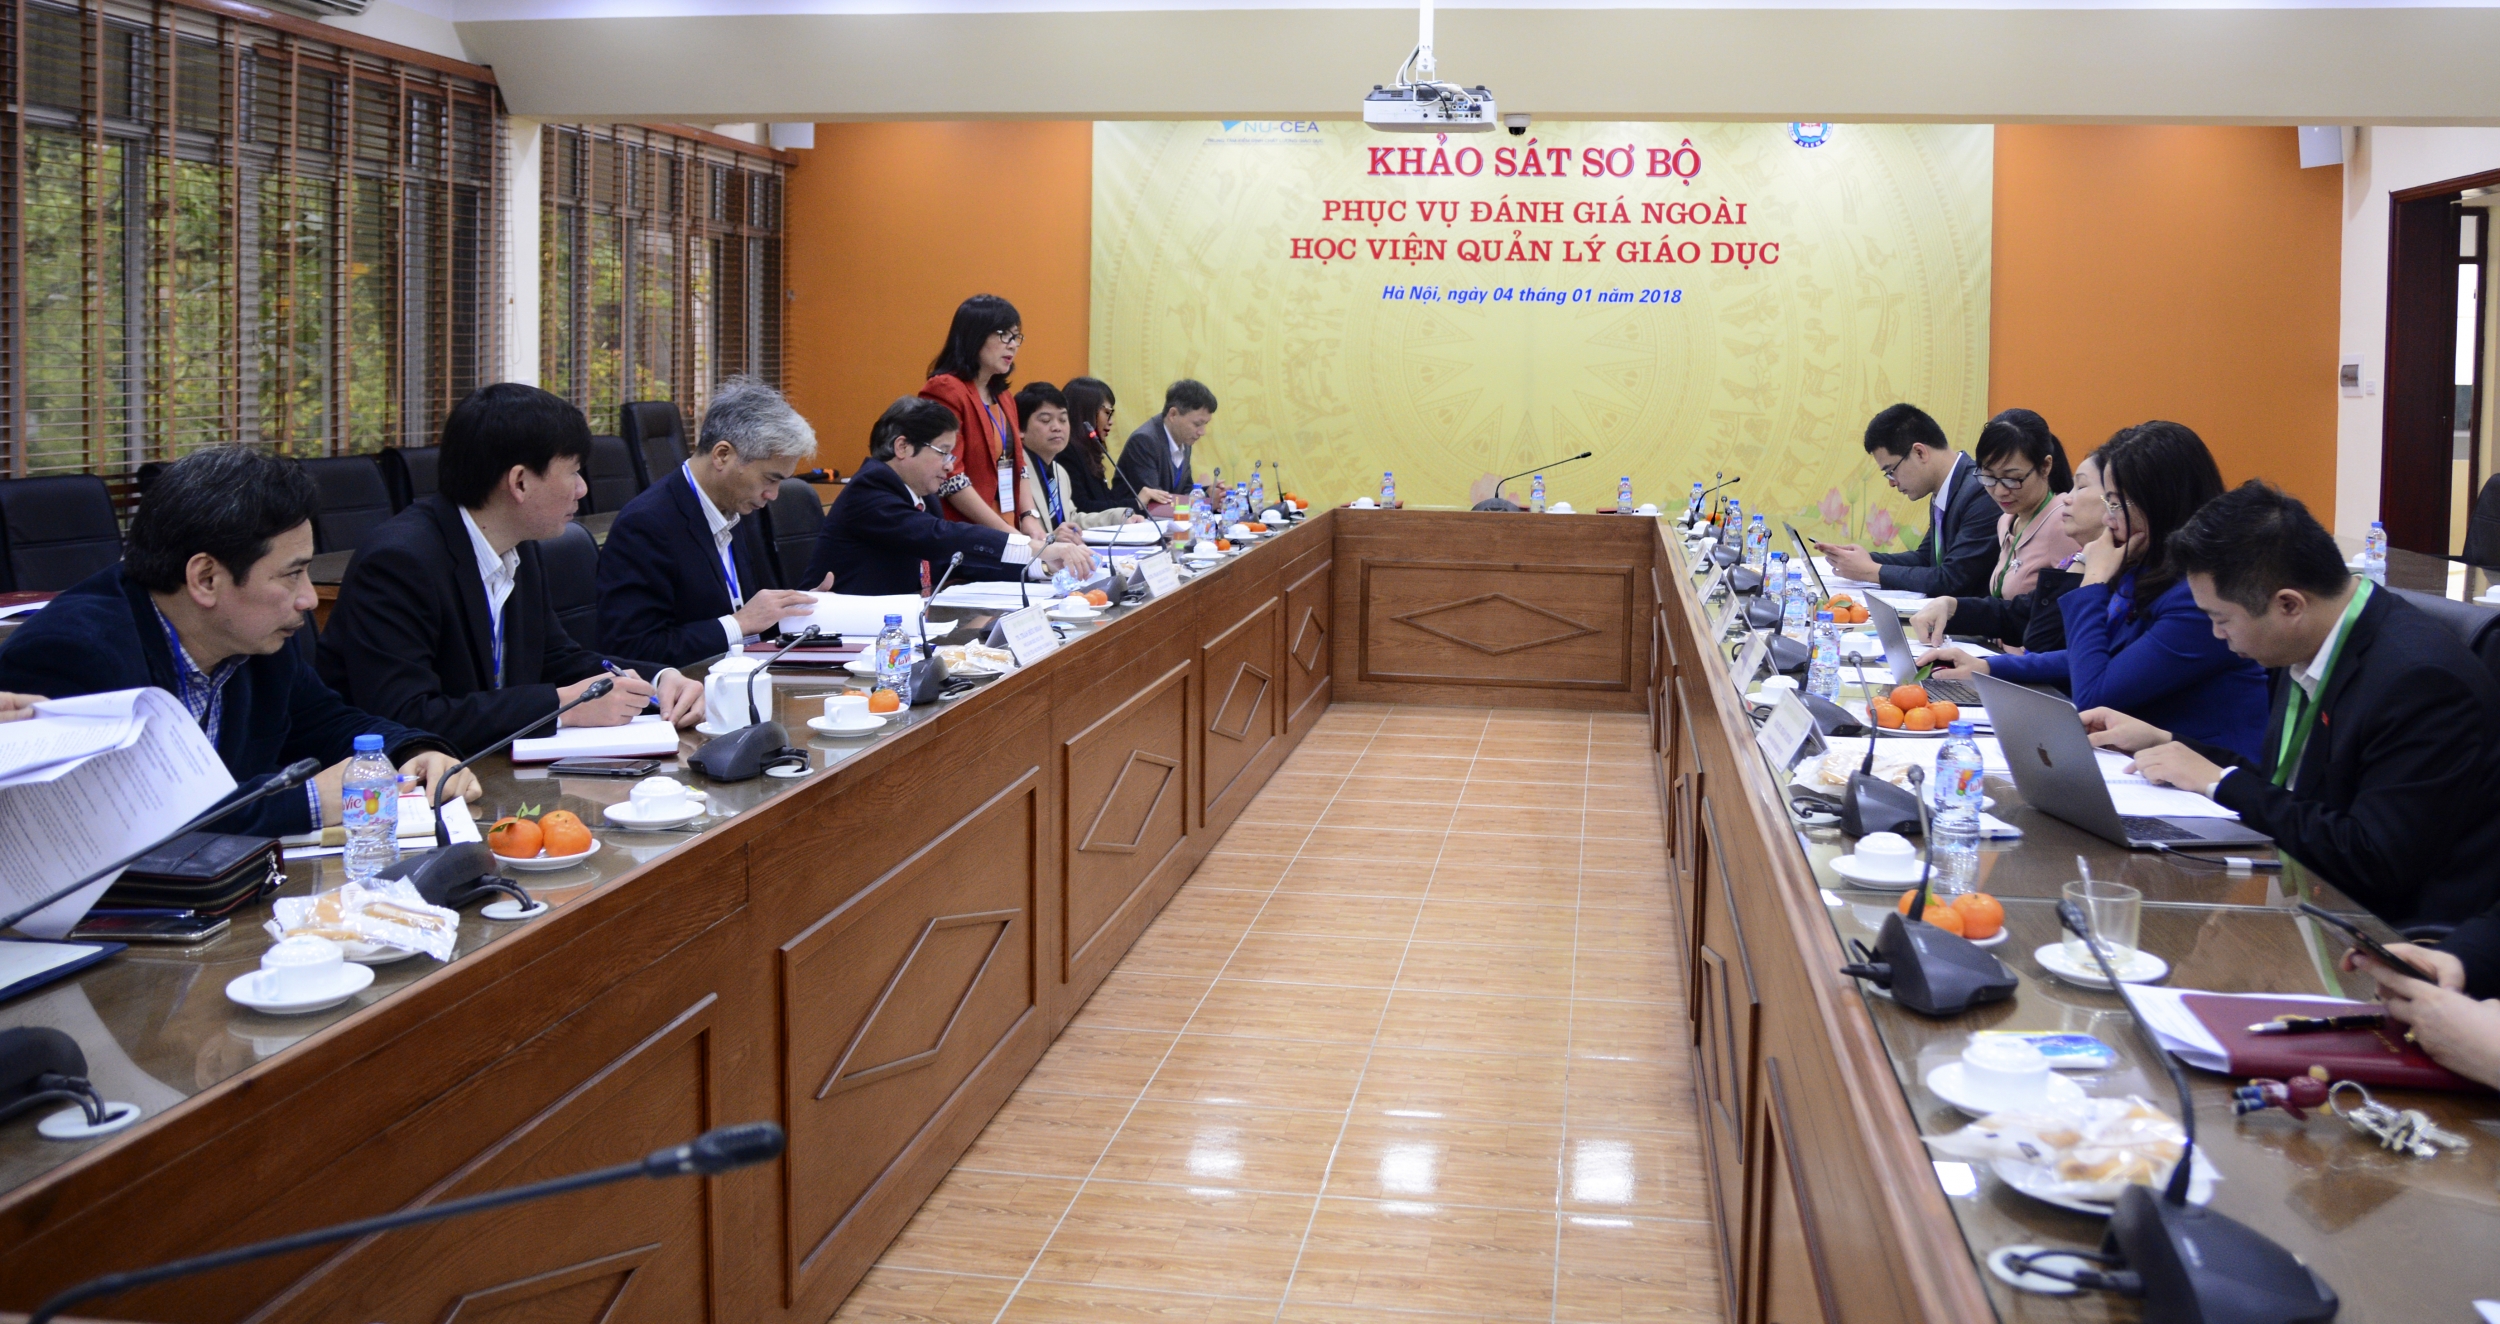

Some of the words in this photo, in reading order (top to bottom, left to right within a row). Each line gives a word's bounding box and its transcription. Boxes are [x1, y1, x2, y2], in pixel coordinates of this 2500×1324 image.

[1367, 132, 1483, 177] KHẢO
[1494, 137, 1571, 177] SÁT
[1582, 143, 1634, 177] SƠ
[1646, 138, 1702, 186] BỘ
[1322, 199, 1406, 227] PHỤC
[1416, 200, 1460, 228] VỤ
[1470, 194, 1564, 223] ĐÁNH
[1573, 195, 1631, 224] GIÁ
[1641, 196, 1747, 225] NGOÀI
[1290, 237, 1357, 265] HỌC
[1366, 232, 1447, 266] VIỆN
[1457, 230, 1552, 263] QUẢN
[1563, 233, 1606, 263] LÝ
[1616, 234, 1701, 264] GIÁO
[1711, 242, 1780, 270] DỤC
[1382, 285, 1405, 300] Hà
[1409, 286, 1442, 304] Nội,
[1447, 287, 1488, 304] ngày
[1493, 288, 1514, 301] 04
[1519, 287, 1567, 305] tháng
[1572, 289, 1592, 302] 01
[1598, 289, 1633, 303] năm
[1639, 289, 1683, 303] 2018
